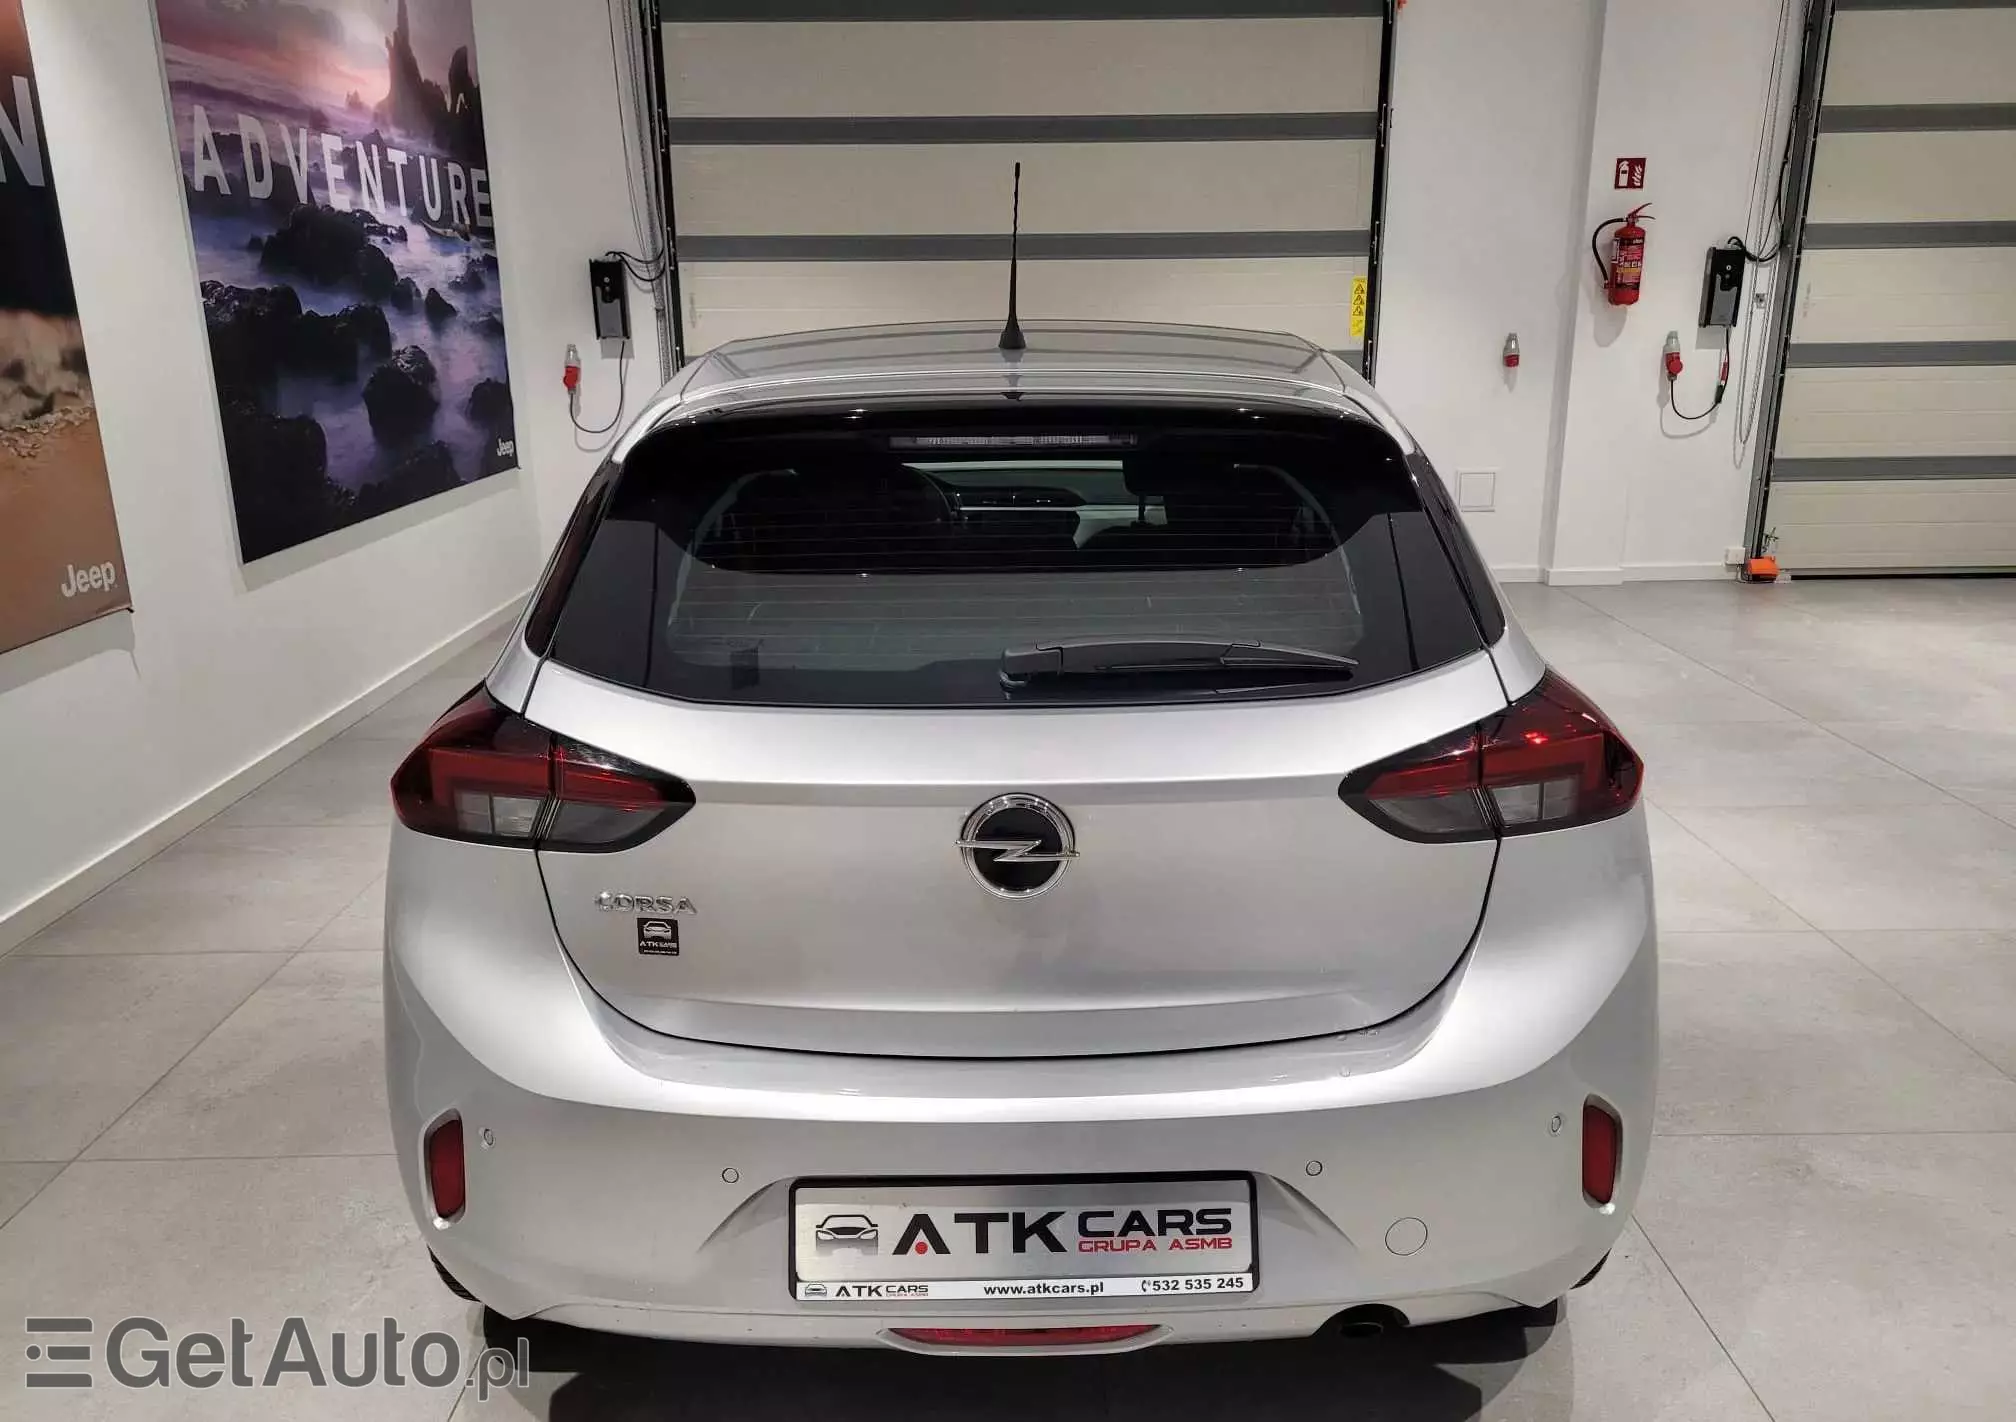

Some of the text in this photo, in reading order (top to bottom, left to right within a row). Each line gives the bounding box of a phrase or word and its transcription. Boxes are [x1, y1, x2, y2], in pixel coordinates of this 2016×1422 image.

[193, 104, 493, 227] ADVENTURE
[496, 437, 515, 457] Jeep
[61, 561, 116, 597] Jeep
[595, 889, 697, 916] CORSA
[892, 1208, 1232, 1255] ATK CARS
[1078, 1237, 1232, 1253] GRUPA ASMB
[835, 1285, 929, 1297] ATK CARS
[984, 1282, 1104, 1296] www.atkcars.pl
[1152, 1277, 1244, 1291] 532 535 245
